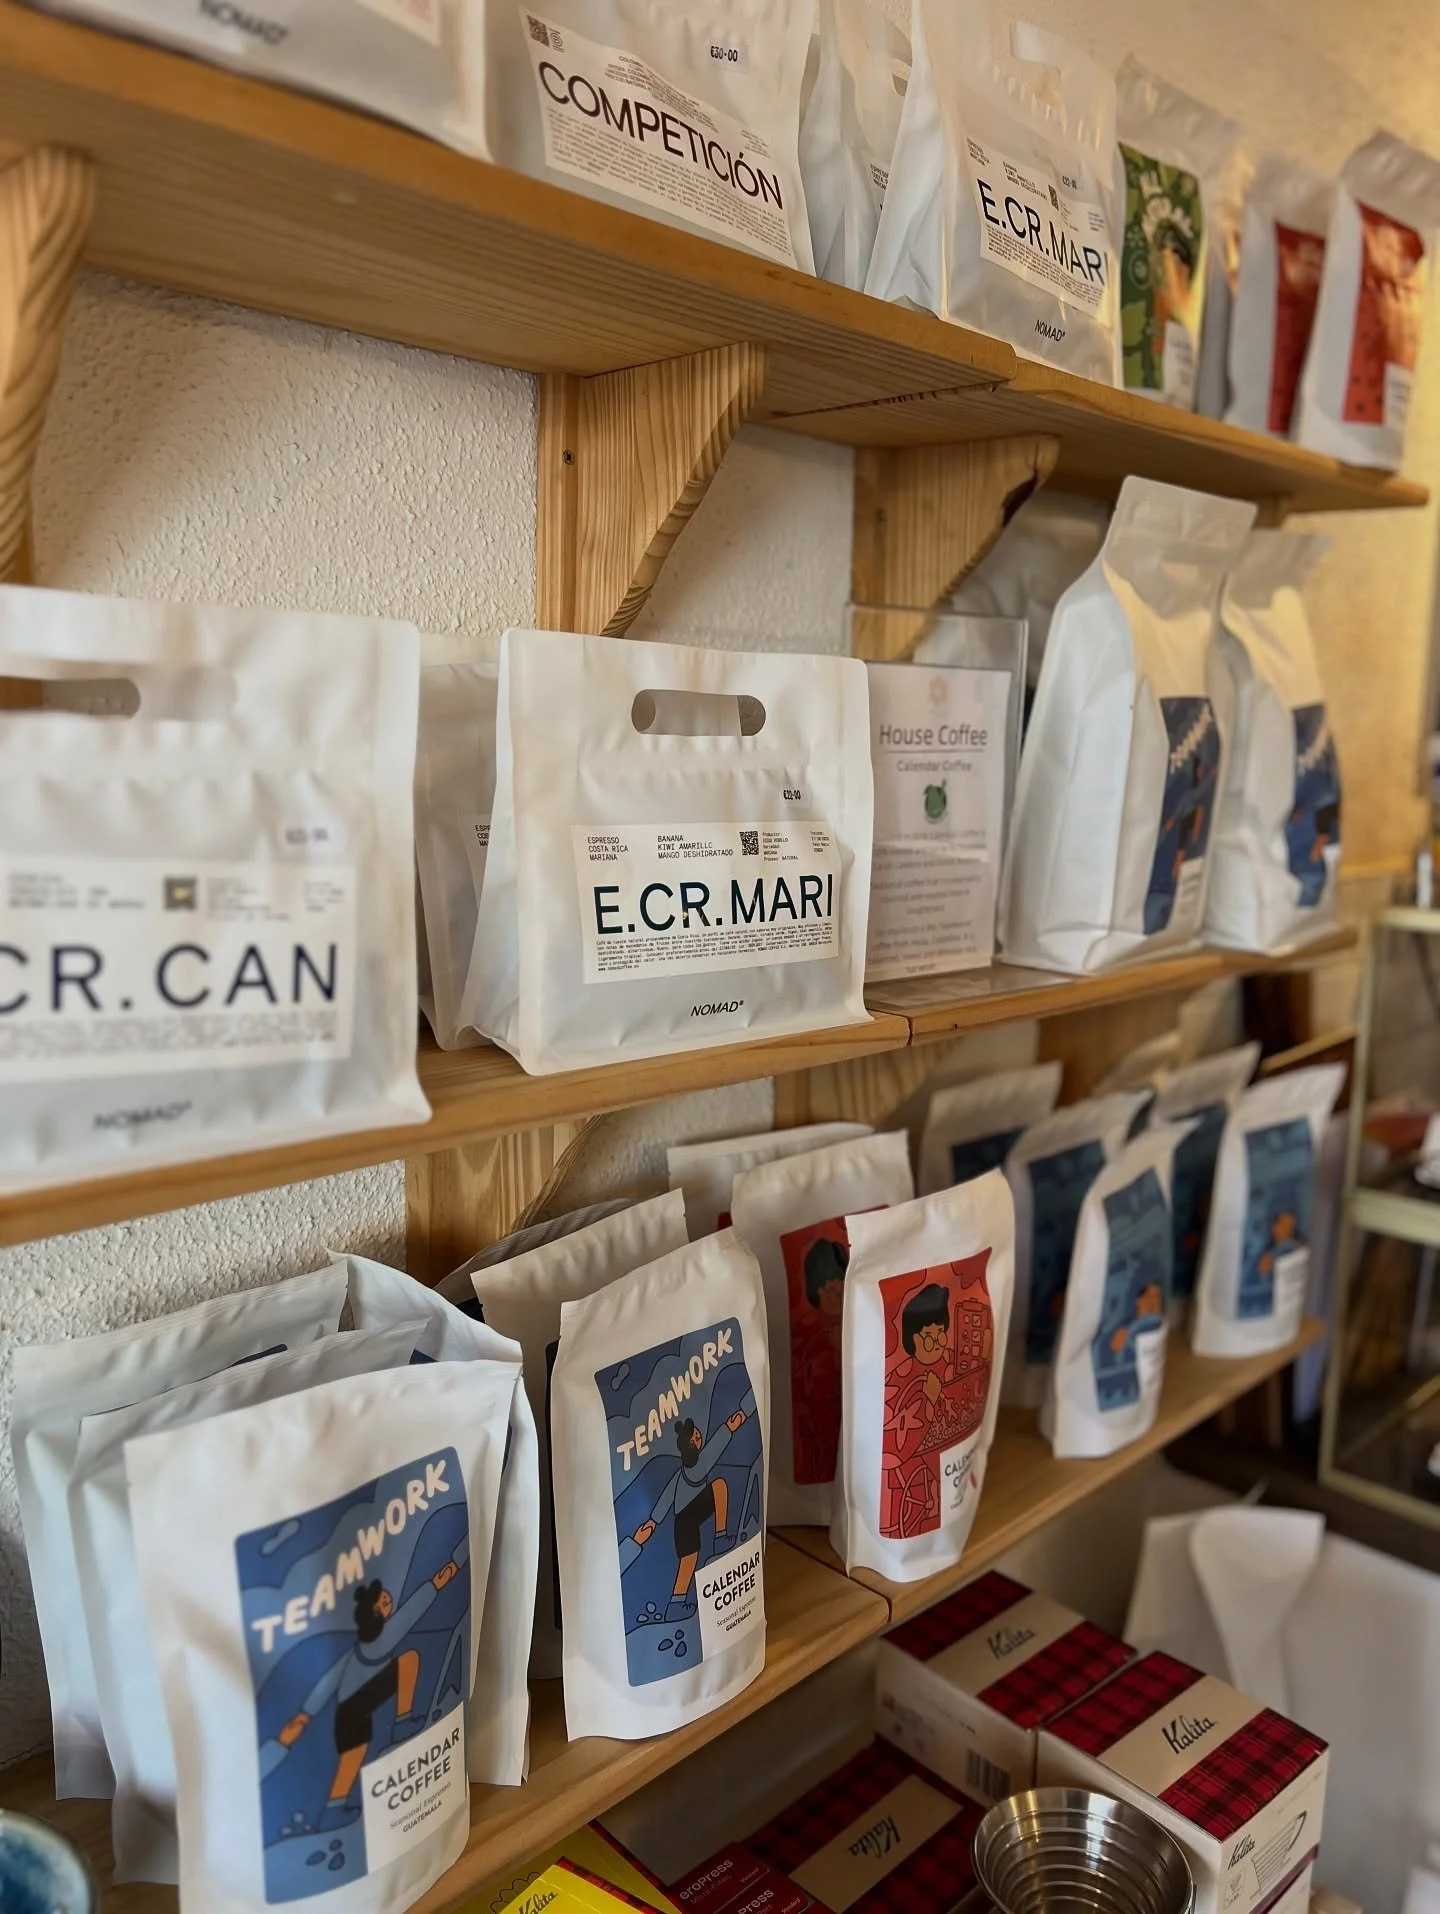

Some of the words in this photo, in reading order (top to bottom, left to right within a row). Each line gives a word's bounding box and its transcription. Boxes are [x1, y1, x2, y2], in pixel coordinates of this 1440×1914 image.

[538, 61, 783, 210] COMPETICIÓN
[879, 725, 934, 747] House
[937, 724, 988, 747] Coffee
[896, 759, 941, 773] Calendar
[942, 760, 972, 772] Coffee
[587, 836, 620, 844] ESPRESSO
[588, 845, 609, 853] COSTA
[611, 844, 629, 852] RICA
[657, 835, 684, 843] BANANA
[657, 843, 675, 851] KIWI
[657, 851, 680, 859] MANGO
[683, 849, 734, 858] DESHIDRATADO
[589, 853, 618, 861] MARIANA
[593, 874, 833, 935] E.CR.MARI
[616, 1328, 733, 1471] TEAMWORK
[251, 1459, 450, 1654] TEAMWORK
[702, 1552, 760, 1598] CALENDAR
[714, 1574, 756, 1611] COFFEE
[716, 1608, 739, 1627] Seasonal
[725, 1609, 751, 1632] GUATEMALA
[987, 1627, 1036, 1660] Kalita
[1161, 1714, 1218, 1755] Kalita
[371, 1728, 460, 1798] CALENDAR
[387, 1756, 451, 1810] COFFEE
[389, 1804, 422, 1829] Seasonal
[402, 1800, 442, 1833] GUATEMALA
[847, 1814, 901, 1859] Kalita
[1228, 1833, 1256, 1870] Kalita
[679, 1859, 734, 1900] eroPress
